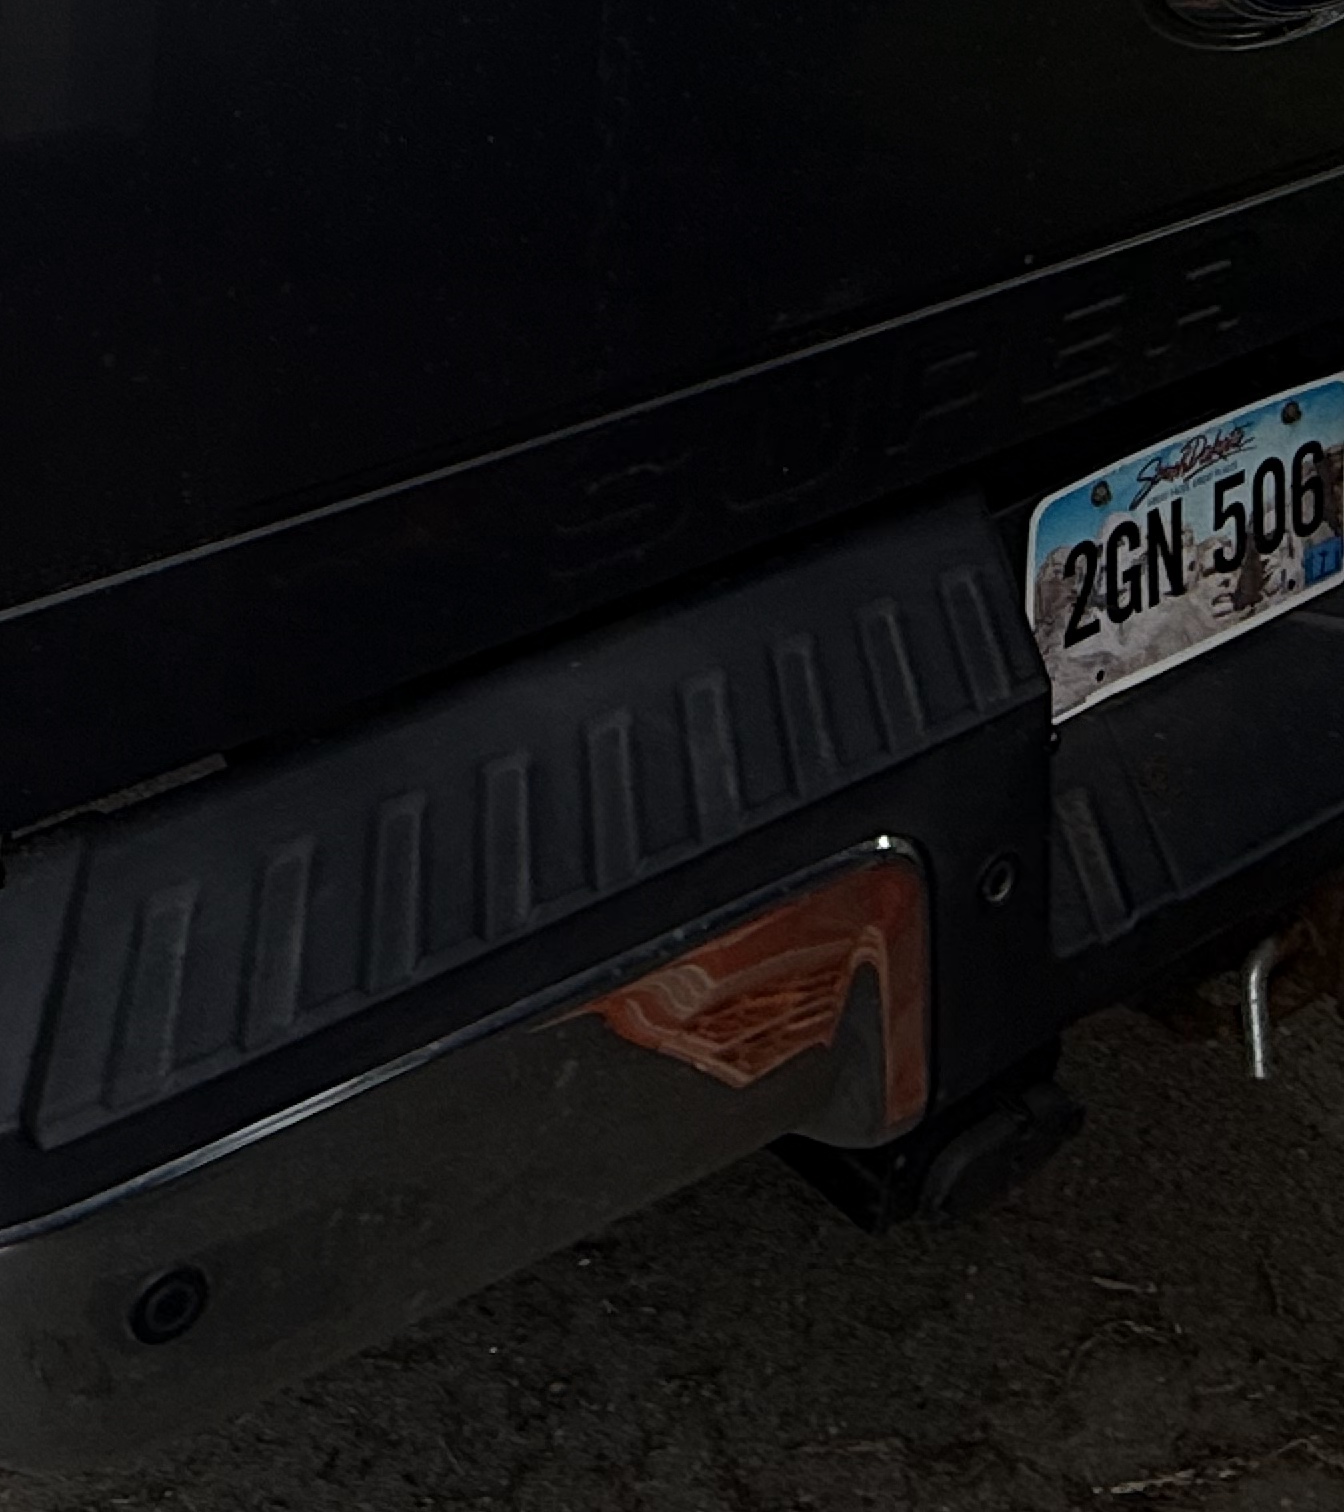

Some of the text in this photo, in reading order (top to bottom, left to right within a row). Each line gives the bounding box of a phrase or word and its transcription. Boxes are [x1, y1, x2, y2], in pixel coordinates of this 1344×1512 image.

[544, 228, 1268, 583] SUPER
[1062, 439, 1326, 650] 2GN 506
